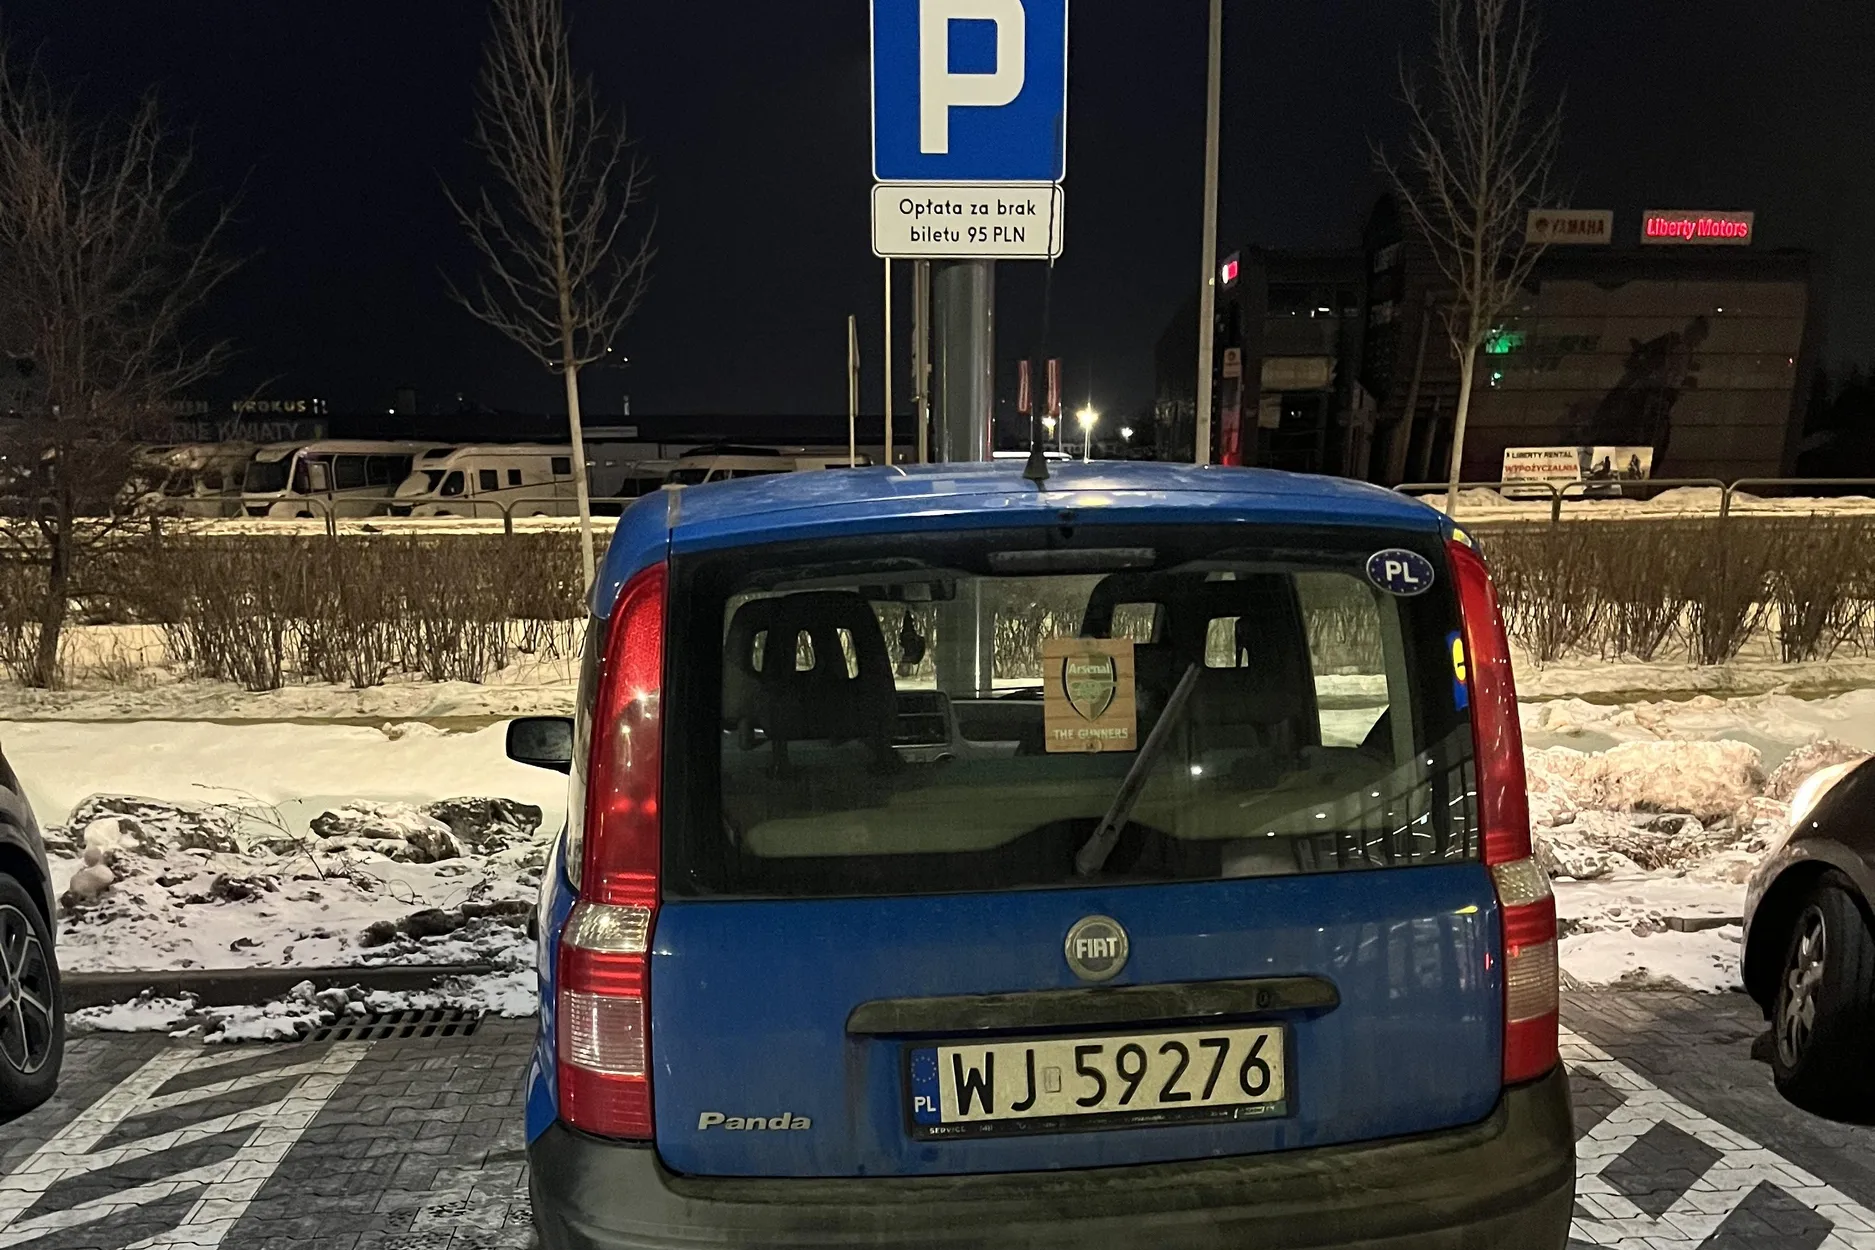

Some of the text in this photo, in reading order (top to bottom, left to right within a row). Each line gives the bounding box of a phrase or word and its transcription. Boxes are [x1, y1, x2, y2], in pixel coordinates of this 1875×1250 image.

[919, 0, 1026, 154] P
[899, 199, 1036, 219] Opłata za brak
[910, 227, 1025, 242] biletu 95 PLN
[1552, 219, 1604, 235] YAMAHA
[1646, 218, 1748, 240] Liberty Motors
[1505, 463, 1578, 472] WYPOŻYCZALNIA
[1385, 560, 1419, 583] PL
[1068, 663, 1111, 675] Arsenal
[1053, 727, 1129, 740] THE GUNNERS
[1076, 937, 1118, 959] FIAT
[952, 1034, 1271, 1116] WJ 59276
[914, 1096, 937, 1113] PL
[698, 1112, 811, 1130] Panda
